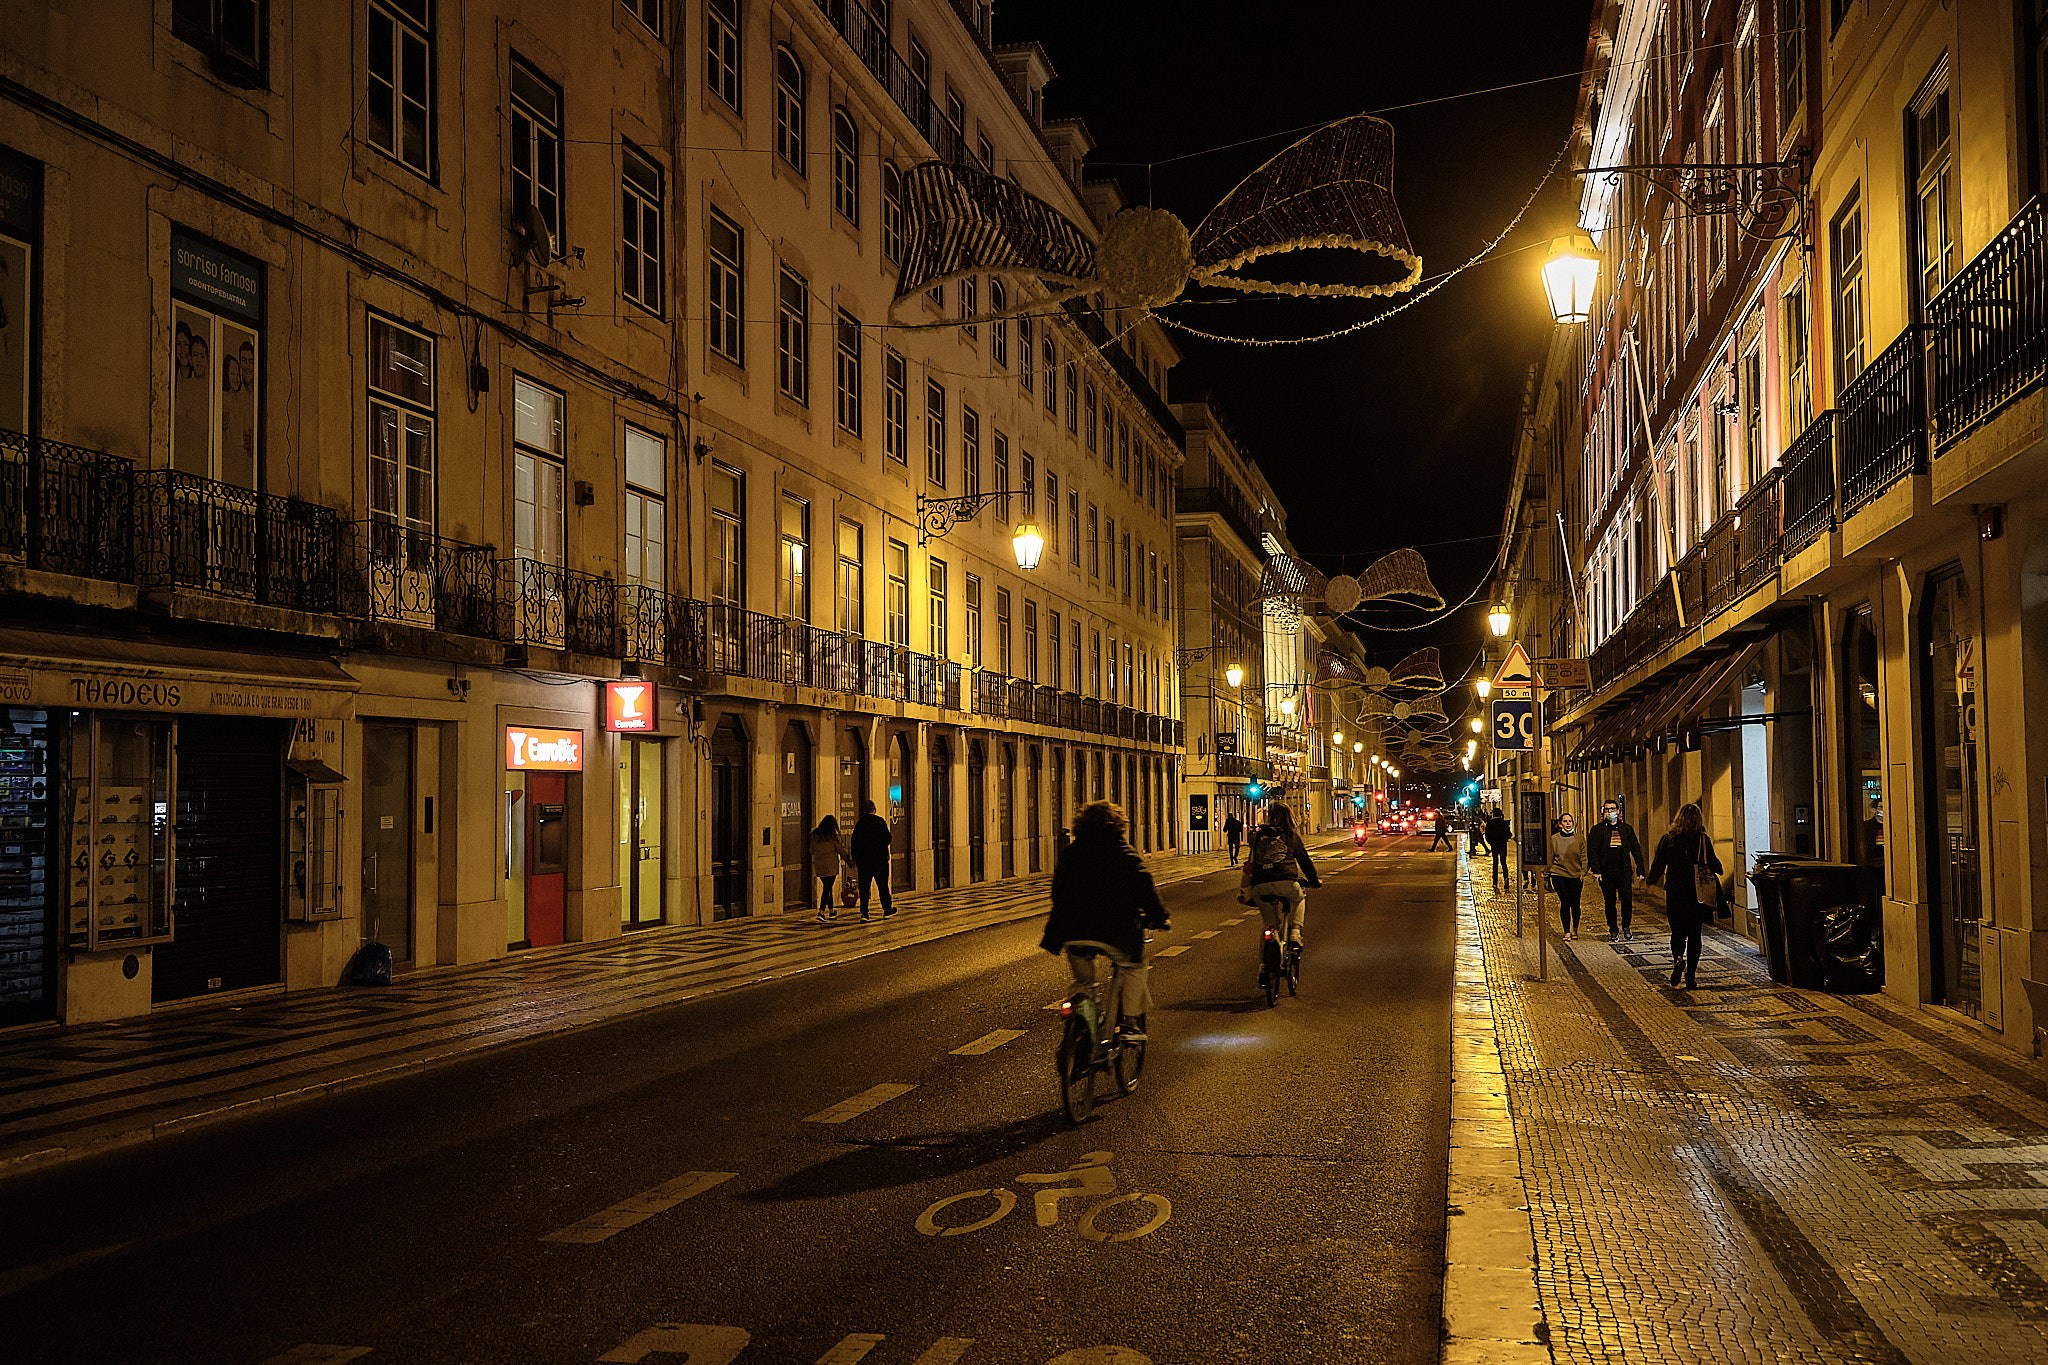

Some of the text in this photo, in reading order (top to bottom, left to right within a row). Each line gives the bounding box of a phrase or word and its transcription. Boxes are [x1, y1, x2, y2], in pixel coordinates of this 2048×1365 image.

[177, 248, 257, 295] sorriso famoso
[188, 277, 247, 307] ODONTOPEDIATRIA
[70, 678, 181, 707] THADEUS
[1505, 689, 1516, 697] 50
